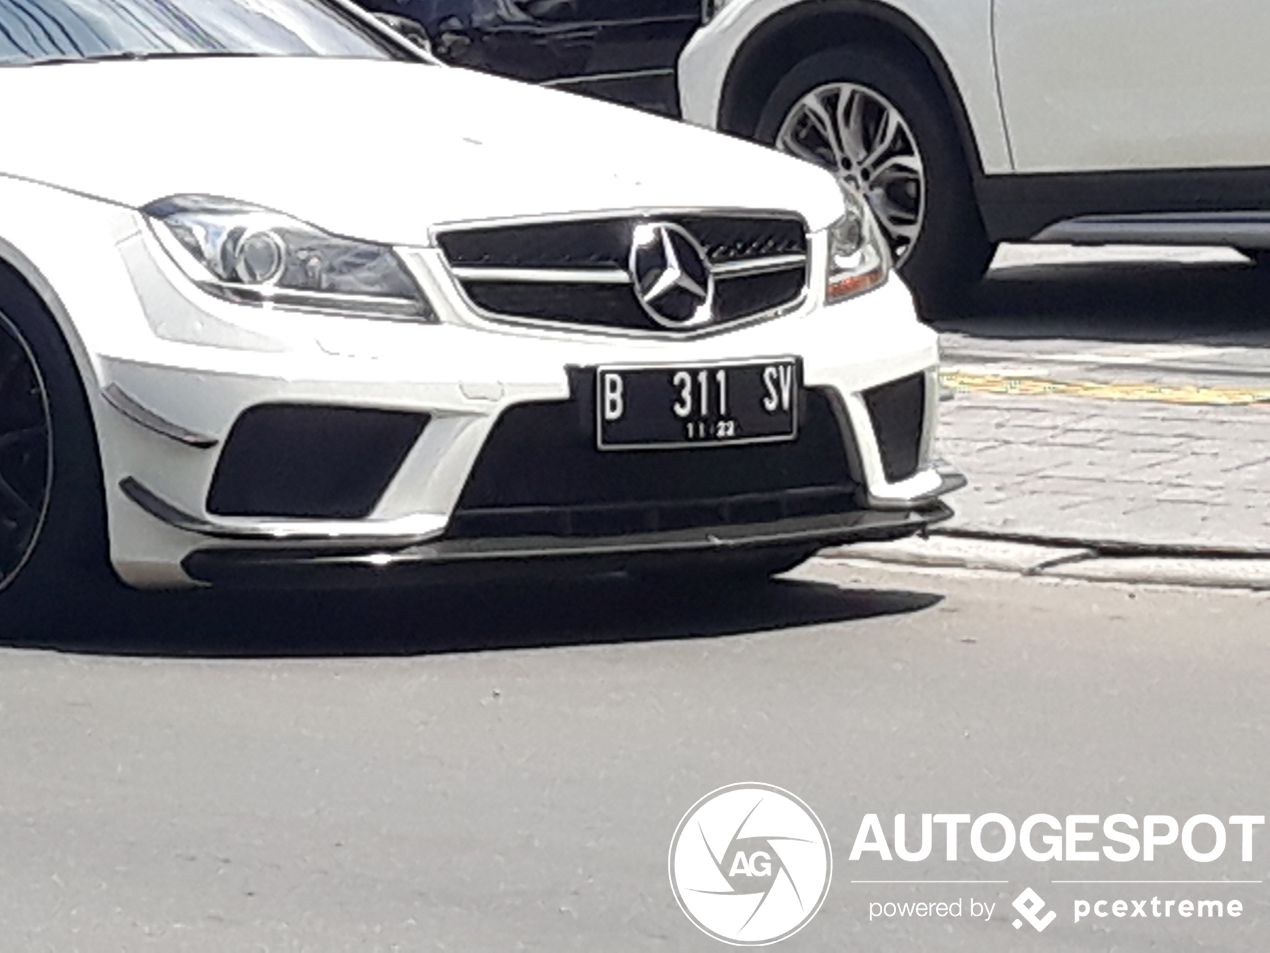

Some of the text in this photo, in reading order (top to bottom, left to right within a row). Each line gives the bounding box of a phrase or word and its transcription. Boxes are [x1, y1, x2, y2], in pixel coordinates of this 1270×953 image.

[604, 365, 792, 421] B 311 SV
